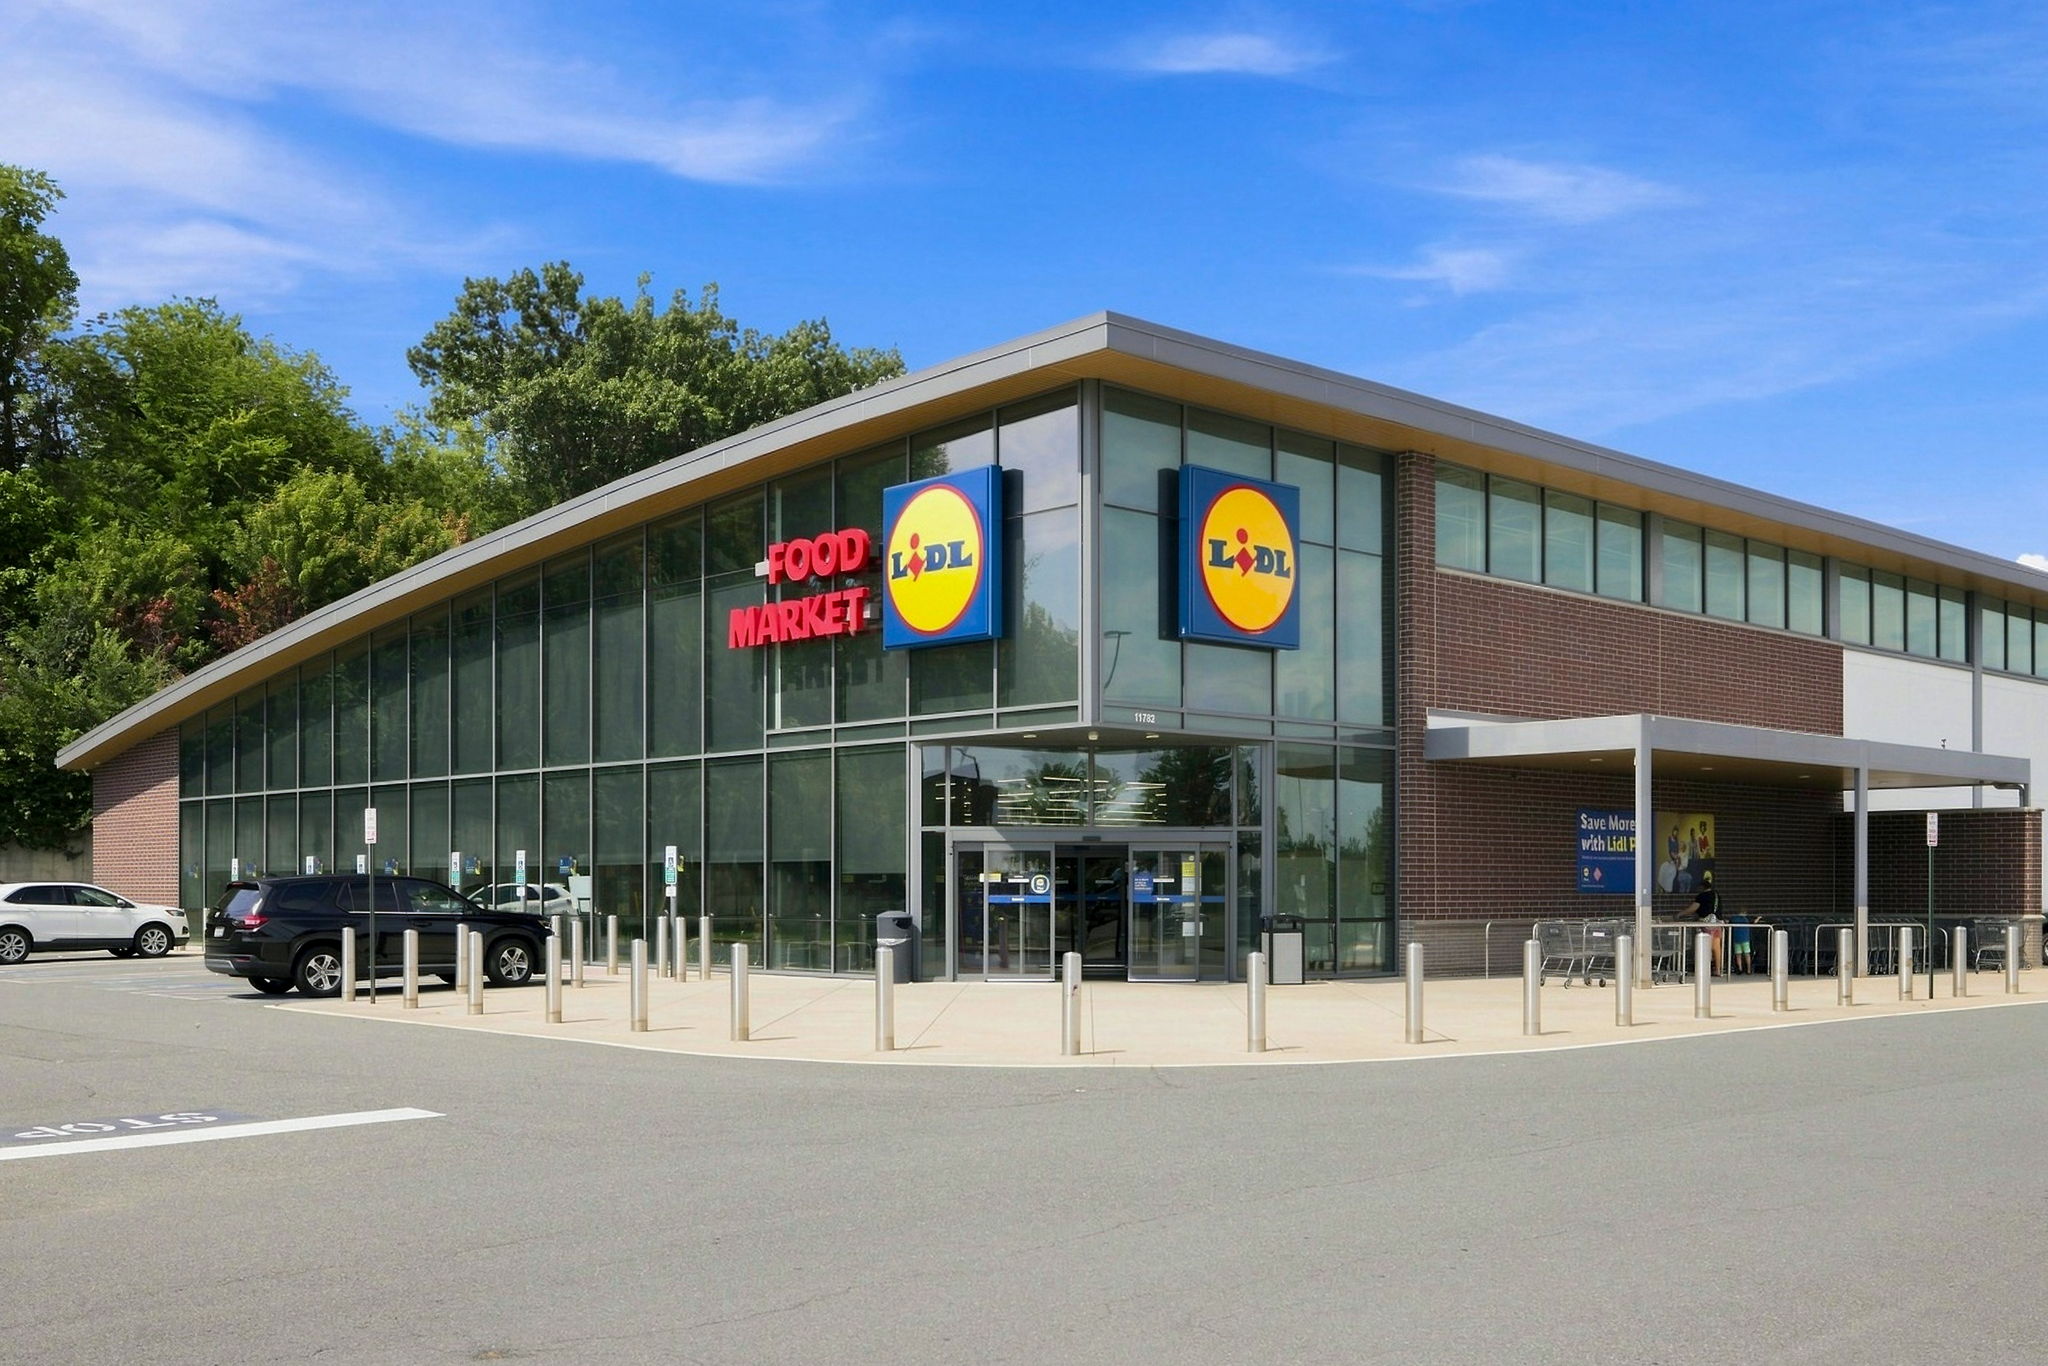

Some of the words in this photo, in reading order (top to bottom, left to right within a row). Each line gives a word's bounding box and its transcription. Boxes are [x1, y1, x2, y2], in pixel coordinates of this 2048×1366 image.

[769, 528, 870, 585] FOOD
[728, 587, 869, 649] MARKET
[1134, 712, 1156, 724] 11782
[1580, 813, 1606, 830] Save
[1608, 814, 1636, 831] More
[1581, 834, 1605, 852] with
[1607, 835, 1627, 852] Lidl
[14, 1112, 219, 1139] STOP
